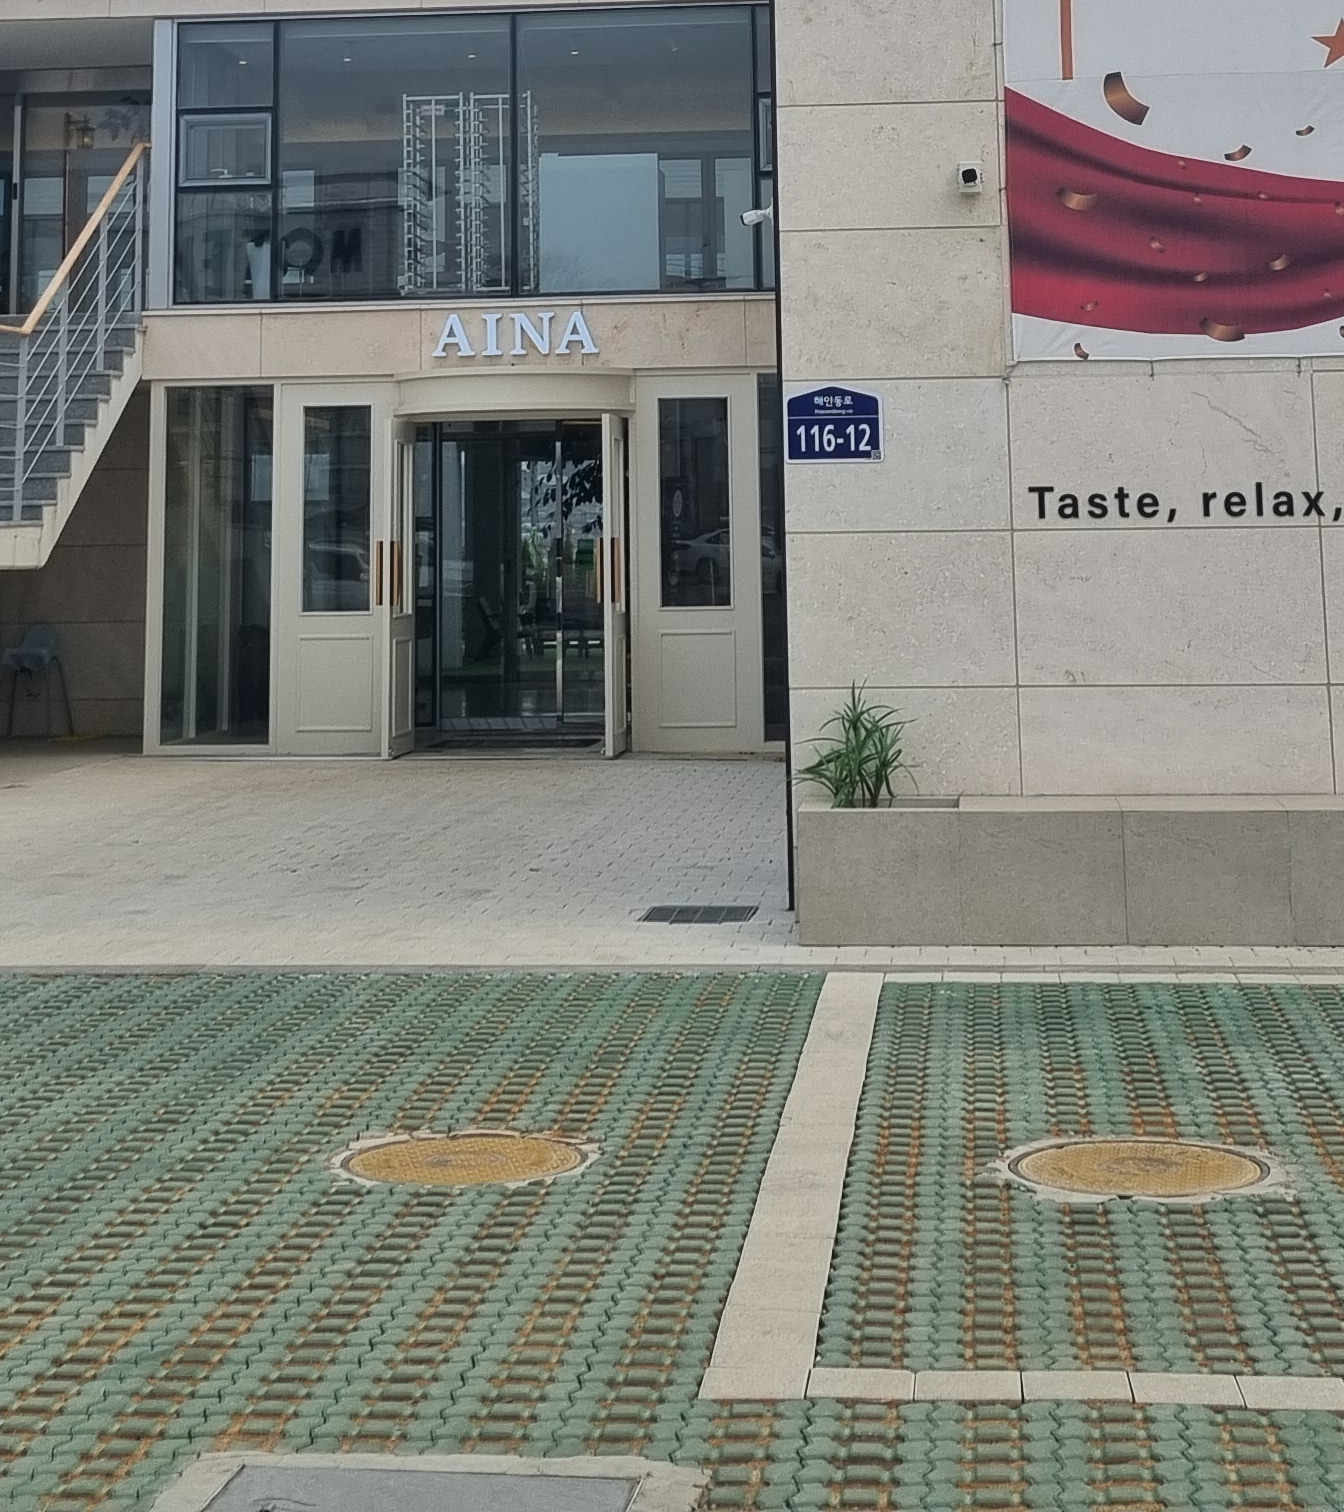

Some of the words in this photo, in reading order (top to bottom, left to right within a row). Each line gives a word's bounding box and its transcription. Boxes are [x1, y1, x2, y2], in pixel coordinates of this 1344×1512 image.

[432, 311, 599, 357] AINA
[796, 423, 872, 452] 116-12
[1027, 486, 1178, 523] Taste,
[1201, 481, 1344, 522] relax,
